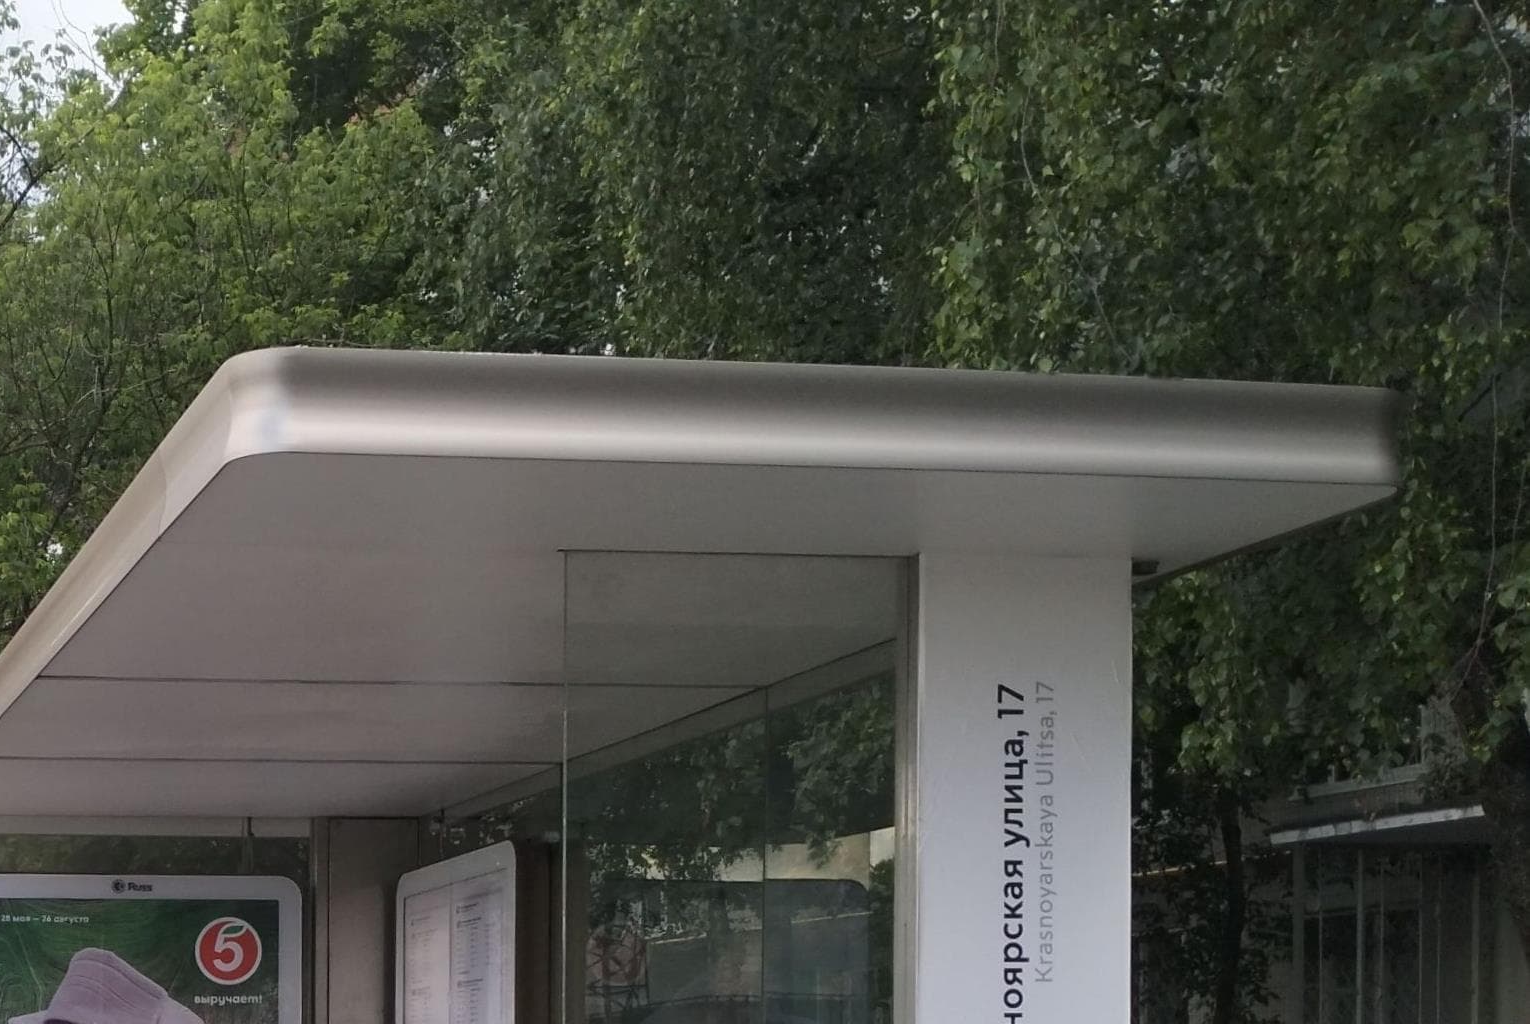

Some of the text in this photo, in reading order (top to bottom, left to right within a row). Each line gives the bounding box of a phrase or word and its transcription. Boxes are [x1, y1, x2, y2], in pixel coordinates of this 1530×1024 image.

[997, 683, 1024, 720] 17
[1003, 730, 1030, 848] улица,
[1035, 681, 1058, 983] Krasnoyarskaya Ulitsa, 17
[53, 915, 90, 925] августа
[213, 922, 246, 972] 5
[194, 994, 263, 1006] выручает!
